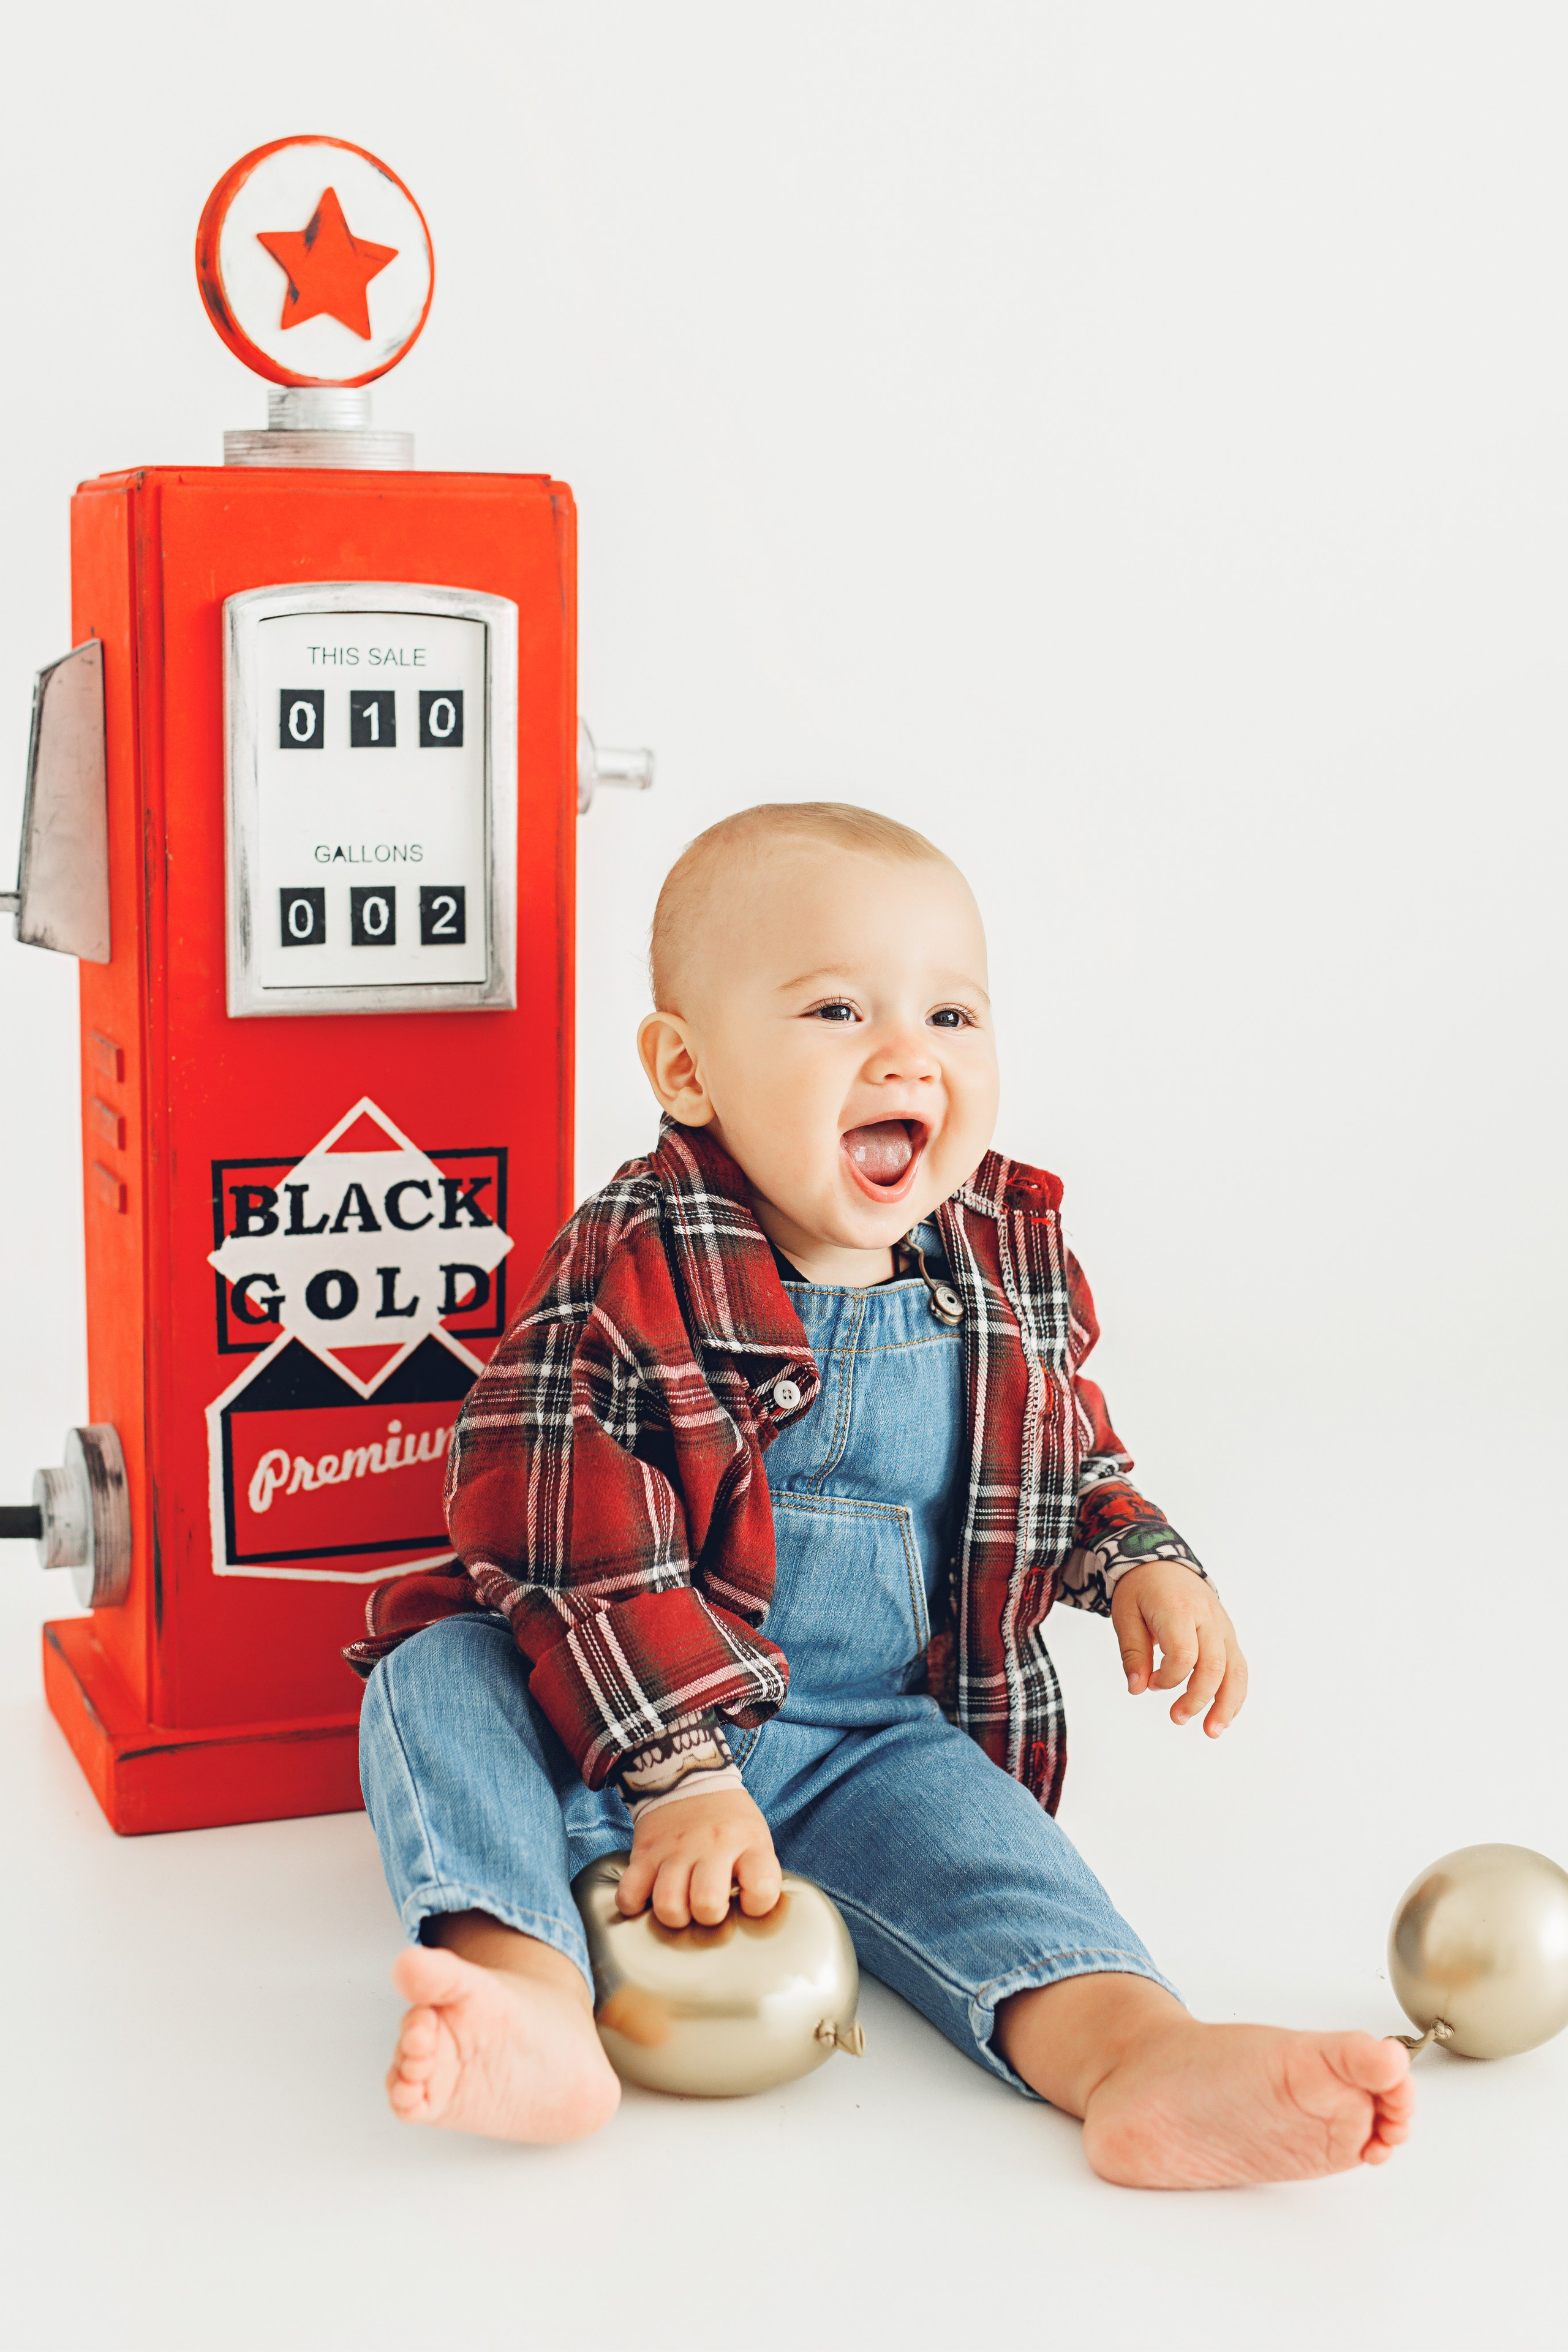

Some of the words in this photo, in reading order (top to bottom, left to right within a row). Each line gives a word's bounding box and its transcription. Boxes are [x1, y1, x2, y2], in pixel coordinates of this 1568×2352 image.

[307, 647, 360, 666] THIS
[368, 647, 426, 666] SALE
[314, 844, 423, 863] GALLONS
[228, 1176, 494, 1238] BLACK
[230, 1263, 491, 1325] GOLD
